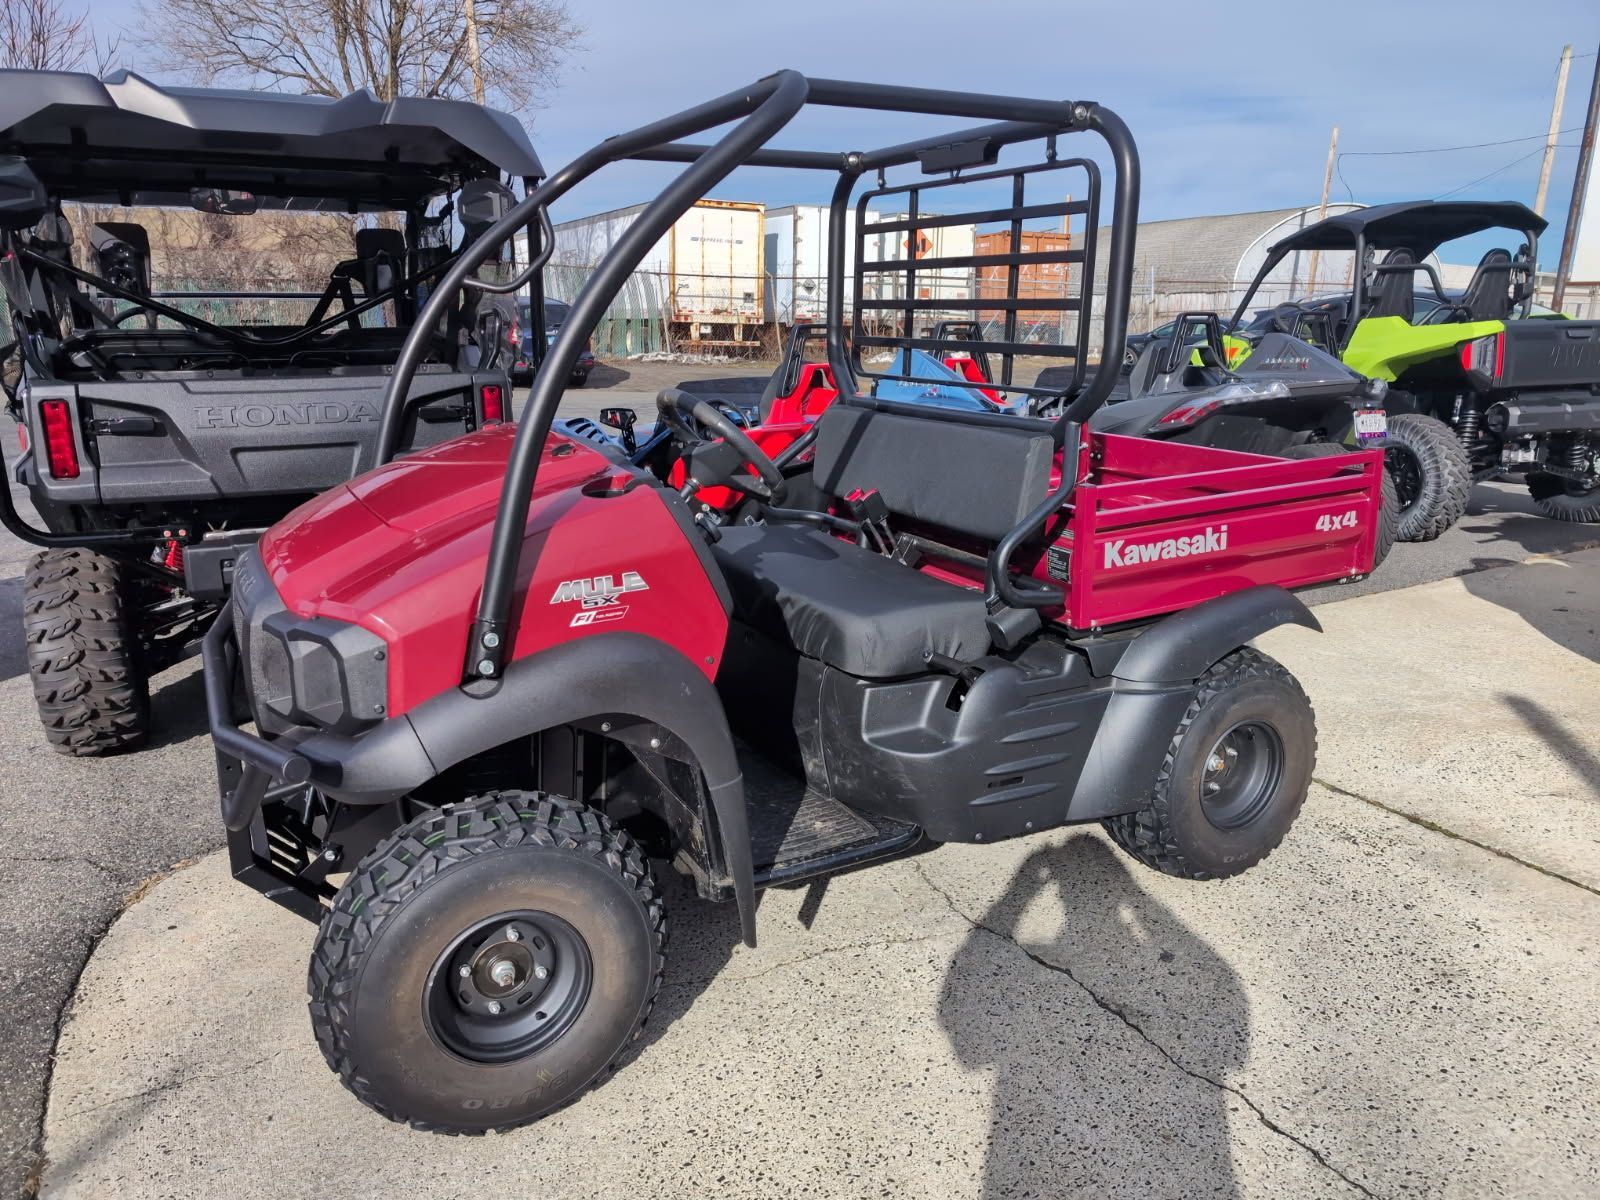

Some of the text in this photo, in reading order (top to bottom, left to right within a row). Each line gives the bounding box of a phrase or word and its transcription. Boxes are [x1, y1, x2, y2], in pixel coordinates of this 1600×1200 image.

[193, 401, 384, 429] HONDA
[1315, 510, 1358, 533] 4x4
[1104, 525, 1228, 569] Kawasaki
[549, 571, 650, 605] MULE
[582, 593, 620, 609] SX
